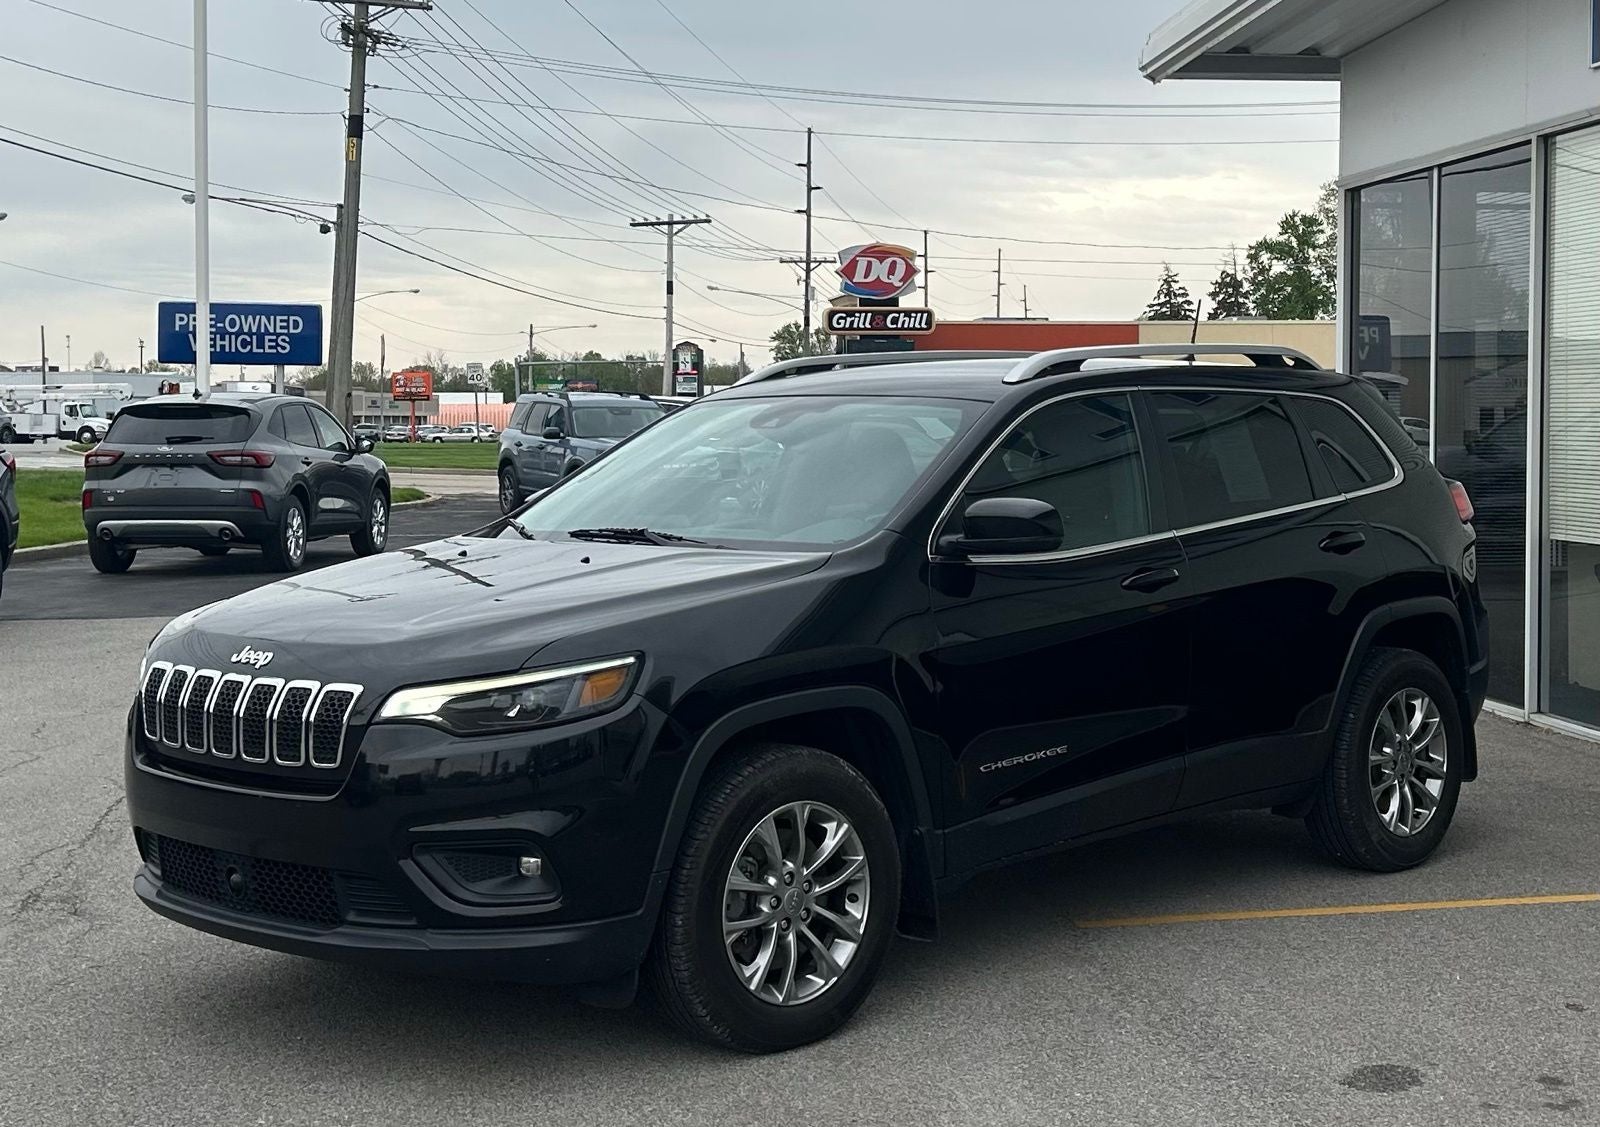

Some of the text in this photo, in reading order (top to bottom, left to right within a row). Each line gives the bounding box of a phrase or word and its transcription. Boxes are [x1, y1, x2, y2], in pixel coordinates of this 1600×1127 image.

[853, 256, 907, 287] DQ
[832, 312, 872, 329] Grill
[886, 312, 928, 329] Chill
[468, 373, 483, 382] 40
[230, 645, 274, 670] Jeep
[980, 745, 1068, 772] CHEROKEE
